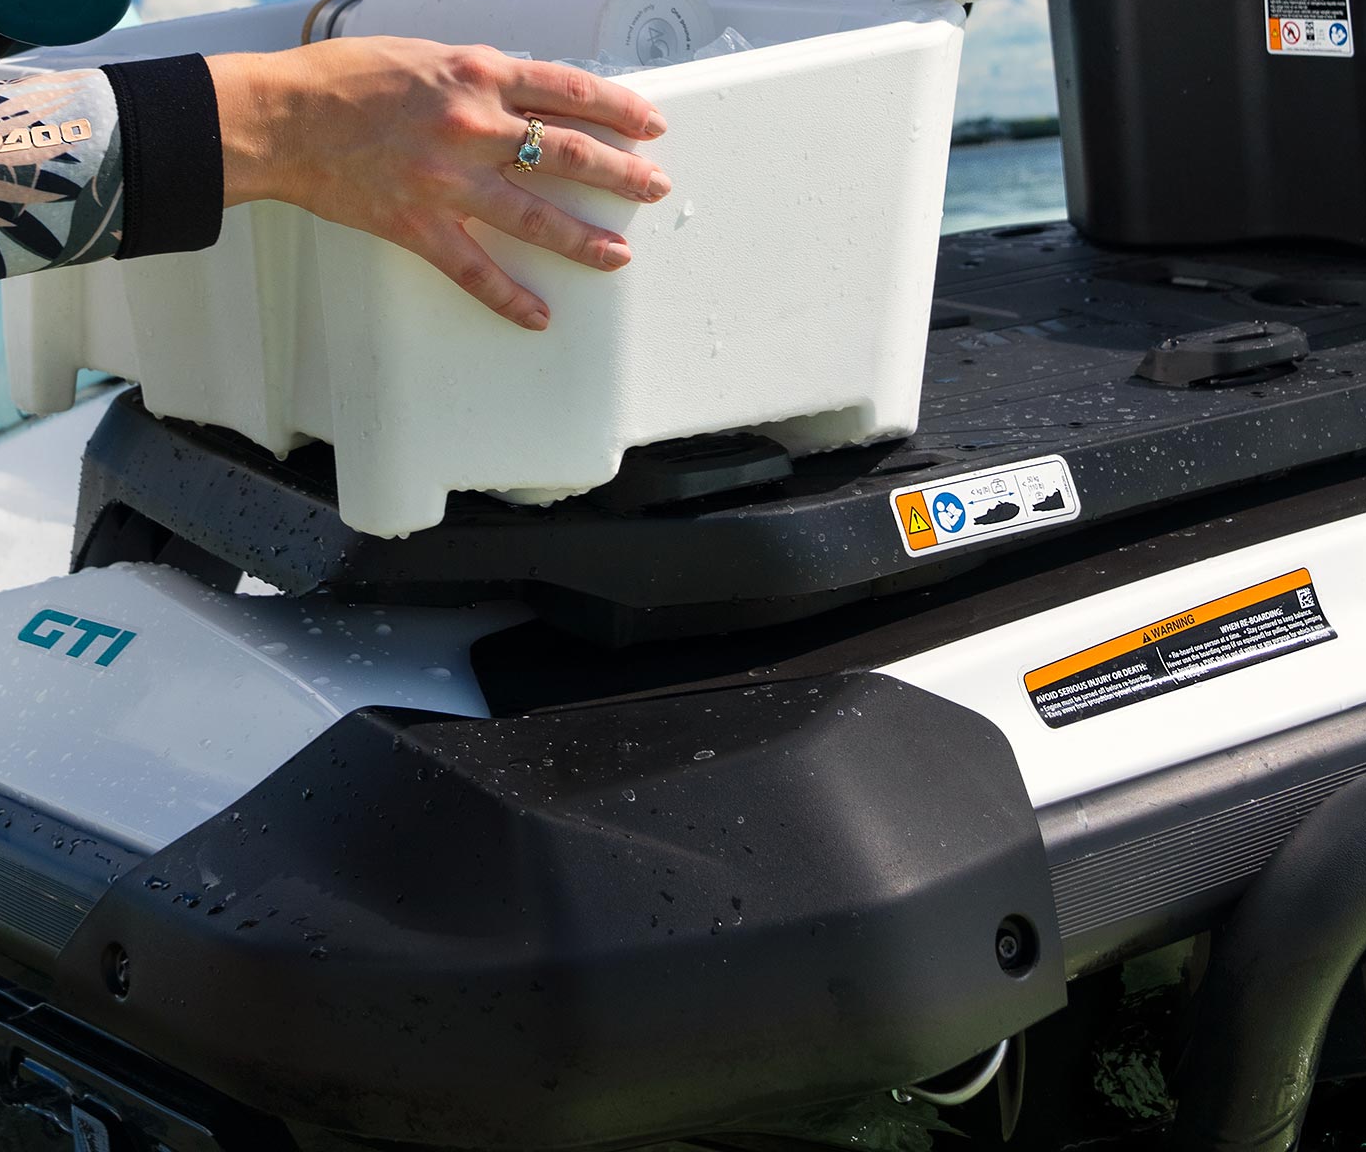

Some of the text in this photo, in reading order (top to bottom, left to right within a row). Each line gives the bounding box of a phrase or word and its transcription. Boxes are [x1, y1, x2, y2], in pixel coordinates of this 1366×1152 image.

[1150, 614, 1194, 637] WARNING
[1219, 608, 1283, 633] WHEN RE-BOARDING:
[17, 609, 137, 667] GTI
[1203, 639, 1219, 649] person
[1036, 663, 1147, 703] AVOID SERIOUS INJURY OR DEATH:
[1042, 702, 1061, 713] Engine
[1061, 697, 1074, 706] must
[1104, 683, 1122, 692] before
